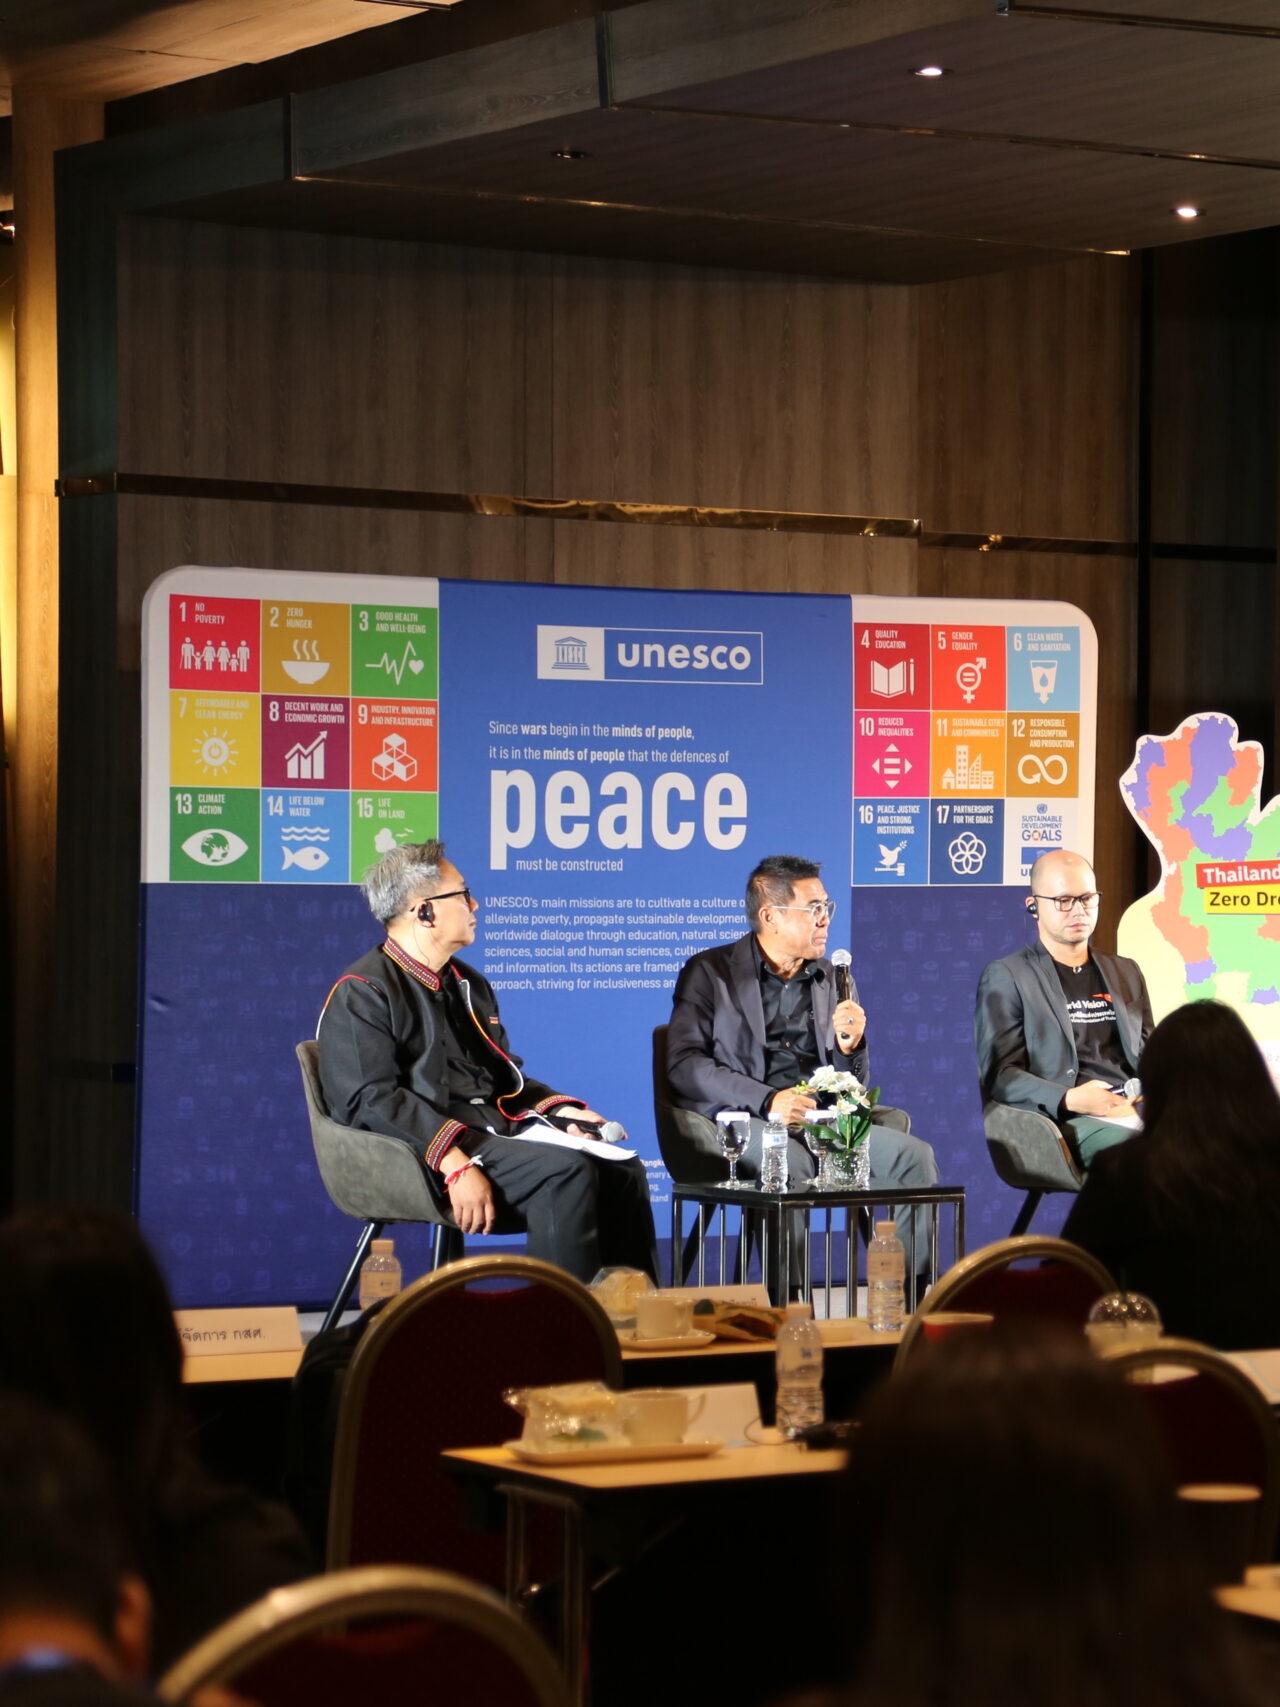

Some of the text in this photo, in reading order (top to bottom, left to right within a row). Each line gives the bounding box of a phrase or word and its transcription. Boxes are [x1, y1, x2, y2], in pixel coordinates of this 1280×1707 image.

[179, 602, 186, 622] 1
[195, 603, 205, 612] NO
[287, 607, 303, 617] ZERO
[195, 614, 225, 624] POVERTY
[270, 607, 280, 628] 2
[359, 611, 368, 631] 3
[376, 611, 418, 622] GOOD HEALTH
[286, 619, 312, 629] HUNGER
[376, 623, 426, 633] AND WELL-BEING
[861, 629, 870, 648] 4
[875, 630, 898, 639] QUALITY
[952, 632, 973, 640] GENDER
[875, 639, 906, 649] EDUCATION
[938, 631, 946, 650] 5
[1014, 633, 1022, 651] 6
[952, 642, 978, 651] EQUALITY
[618, 643, 751, 670] unesco
[178, 697, 187, 718] 7
[269, 702, 279, 722] 8
[285, 702, 343, 712] DECENT WORK AND
[285, 713, 345, 724] ECONOMIC GROWTH
[358, 705, 368, 724] 9
[859, 718, 874, 736] 10
[878, 718, 903, 726] REDUCED
[936, 719, 948, 736] 11
[489, 721, 694, 740] Since wars begin in the minds of people,
[878, 727, 913, 737] INEQUALITIES
[1012, 719, 1025, 737] 12
[489, 747, 729, 763] it is in the minds of people that the defences of
[175, 793, 192, 814] 13
[198, 794, 225, 804] CLIMATE
[289, 796, 325, 806] LIFE BELOW
[378, 799, 391, 807] LIFE
[198, 805, 222, 814] ACTION
[267, 796, 284, 816] 14
[357, 798, 373, 818] 15
[877, 805, 920, 814] PEACE, JUSTICE
[954, 805, 994, 814] PARTNERSHIPS
[289, 807, 310, 817] WATER
[378, 809, 405, 819] ON LAND
[859, 805, 873, 824] 16
[937, 806, 949, 824] 17
[490, 769, 747, 870] peace
[877, 815, 912, 824] AND STRONG
[954, 815, 993, 824] FOR THE GOALS
[877, 825, 914, 834] INSTITUTIONS
[1022, 830, 1062, 841] GOALS
[516, 859, 623, 871] must be constructed
[485, 897, 538, 908] UNESCO's
[542, 899, 567, 908] main
[569, 898, 614, 908] missions
[617, 899, 632, 908] are
[635, 899, 645, 908] to
[648, 898, 690, 908] cultivate
[702, 898, 737, 908] culture
[1209, 892, 1250, 907] Zero
[485, 914, 746, 925] alleviate poverty, propagate sustainable developmen
[485, 930, 538, 940] worldwide
[540, 930, 583, 942] dialogue
[587, 930, 625, 942] through
[628, 930, 680, 941] education,
[682, 930, 717, 939] natural
[484, 946, 672, 957] sciences, social and human sciences,
[484, 963, 504, 973] and
[506, 962, 568, 973] information.
[570, 963, 583, 973] Its
[585, 962, 622, 973] actions
[625, 964, 640, 973] are
[643, 962, 678, 973] framed
[537, 978, 661, 991] striving for inclusiveness
[1082, 1000, 1107, 1009] Vision
